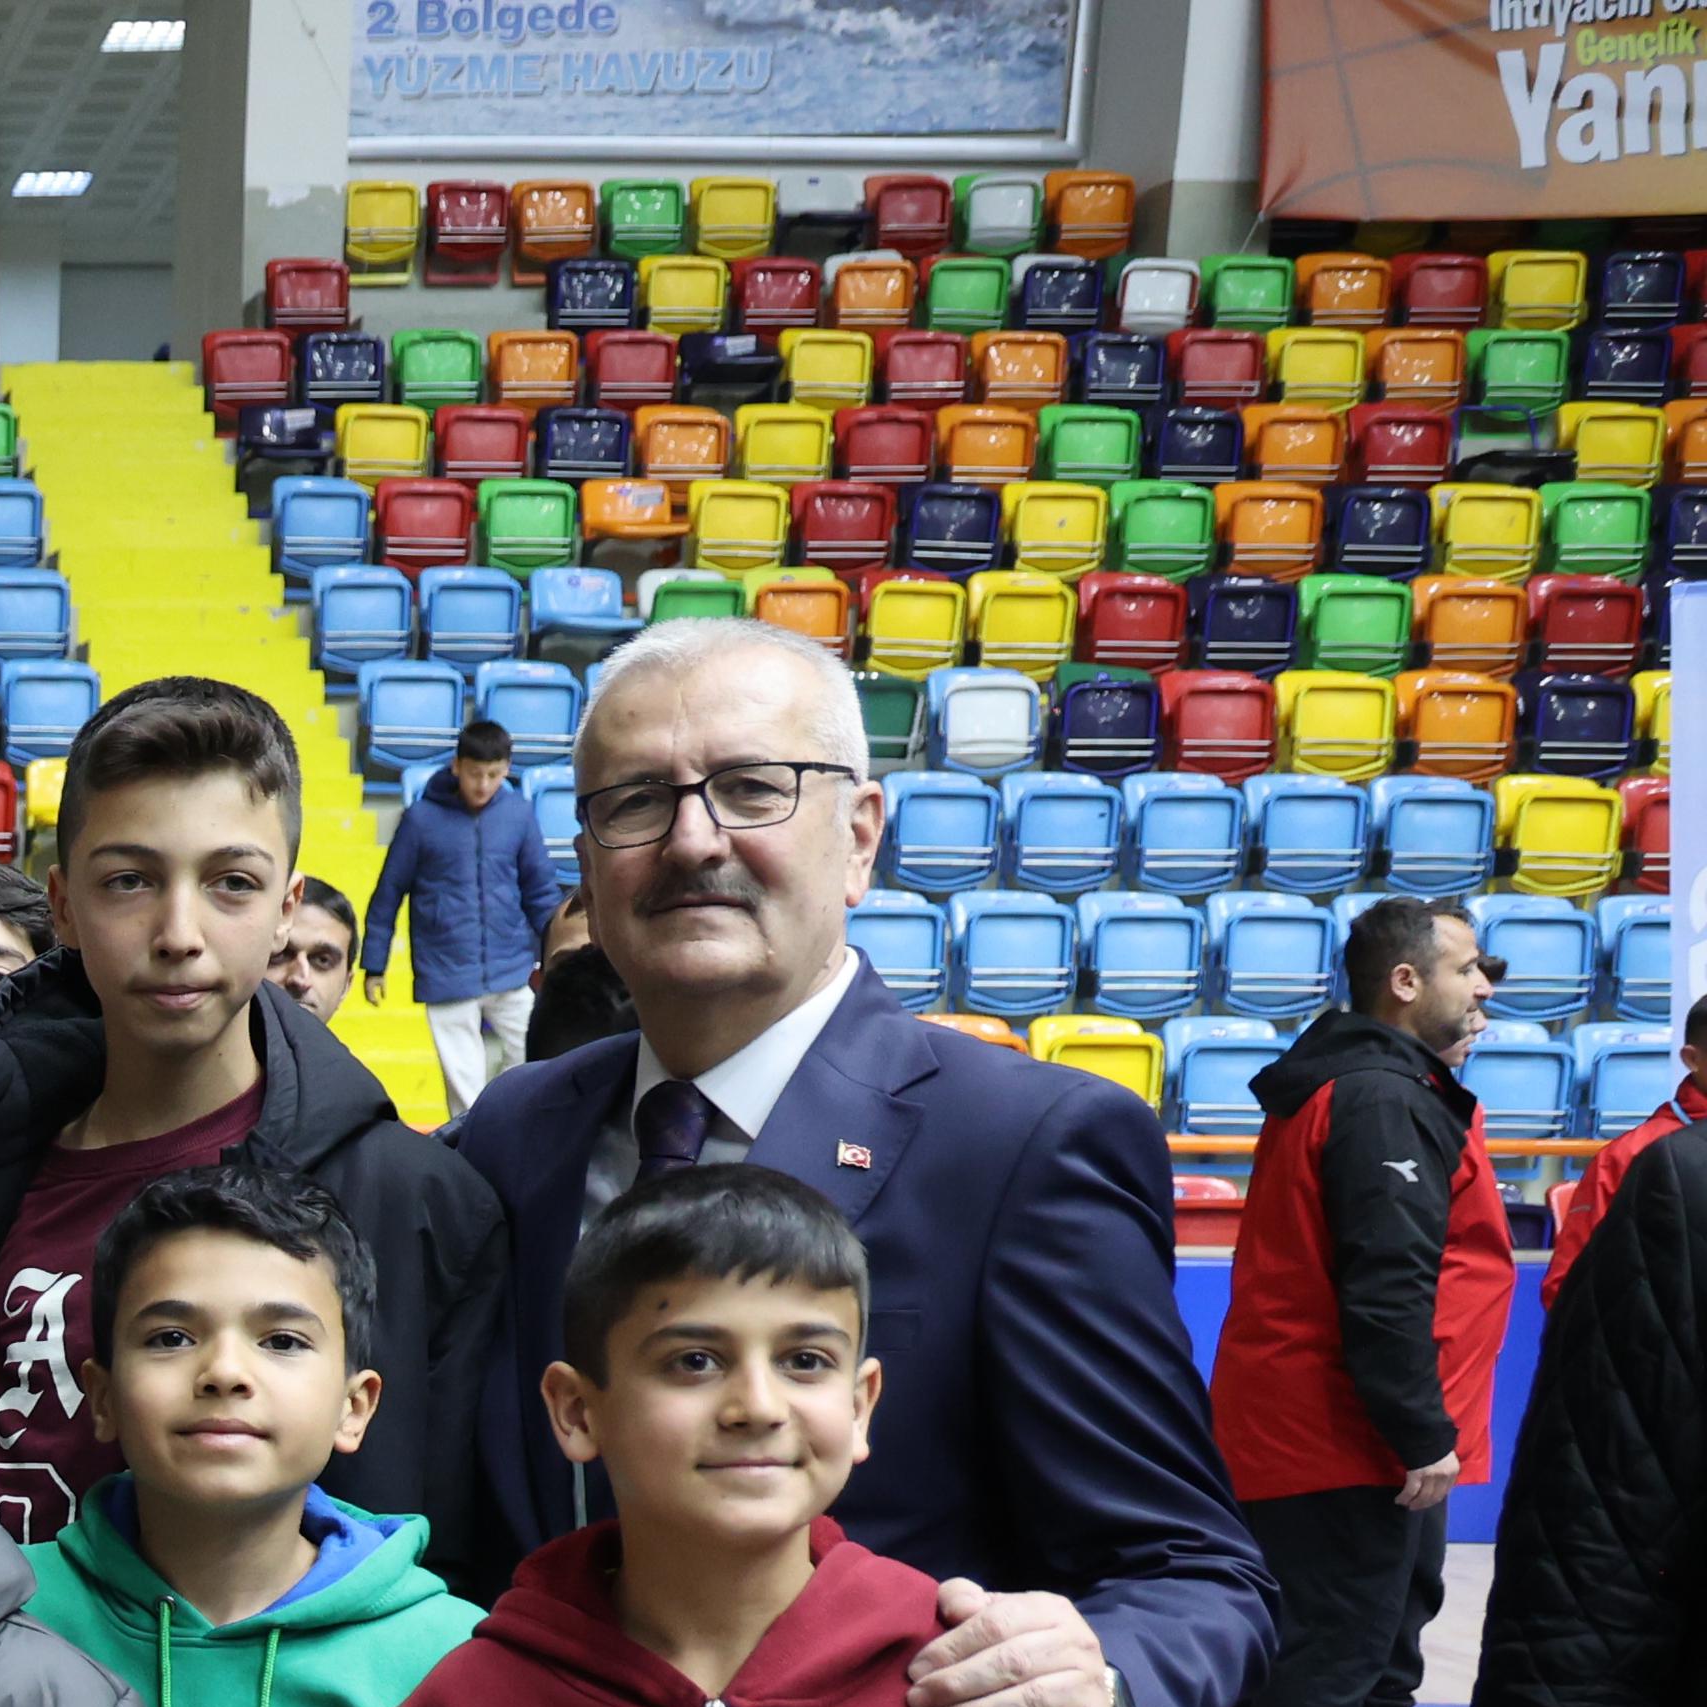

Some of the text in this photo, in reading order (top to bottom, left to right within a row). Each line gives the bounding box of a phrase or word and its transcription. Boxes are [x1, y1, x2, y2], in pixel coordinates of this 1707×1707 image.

[366, 0, 620, 45] 2 Bölgede
[1575, 18, 1697, 69] Gençlik
[362, 47, 774, 98] YÜZME HAVUZU
